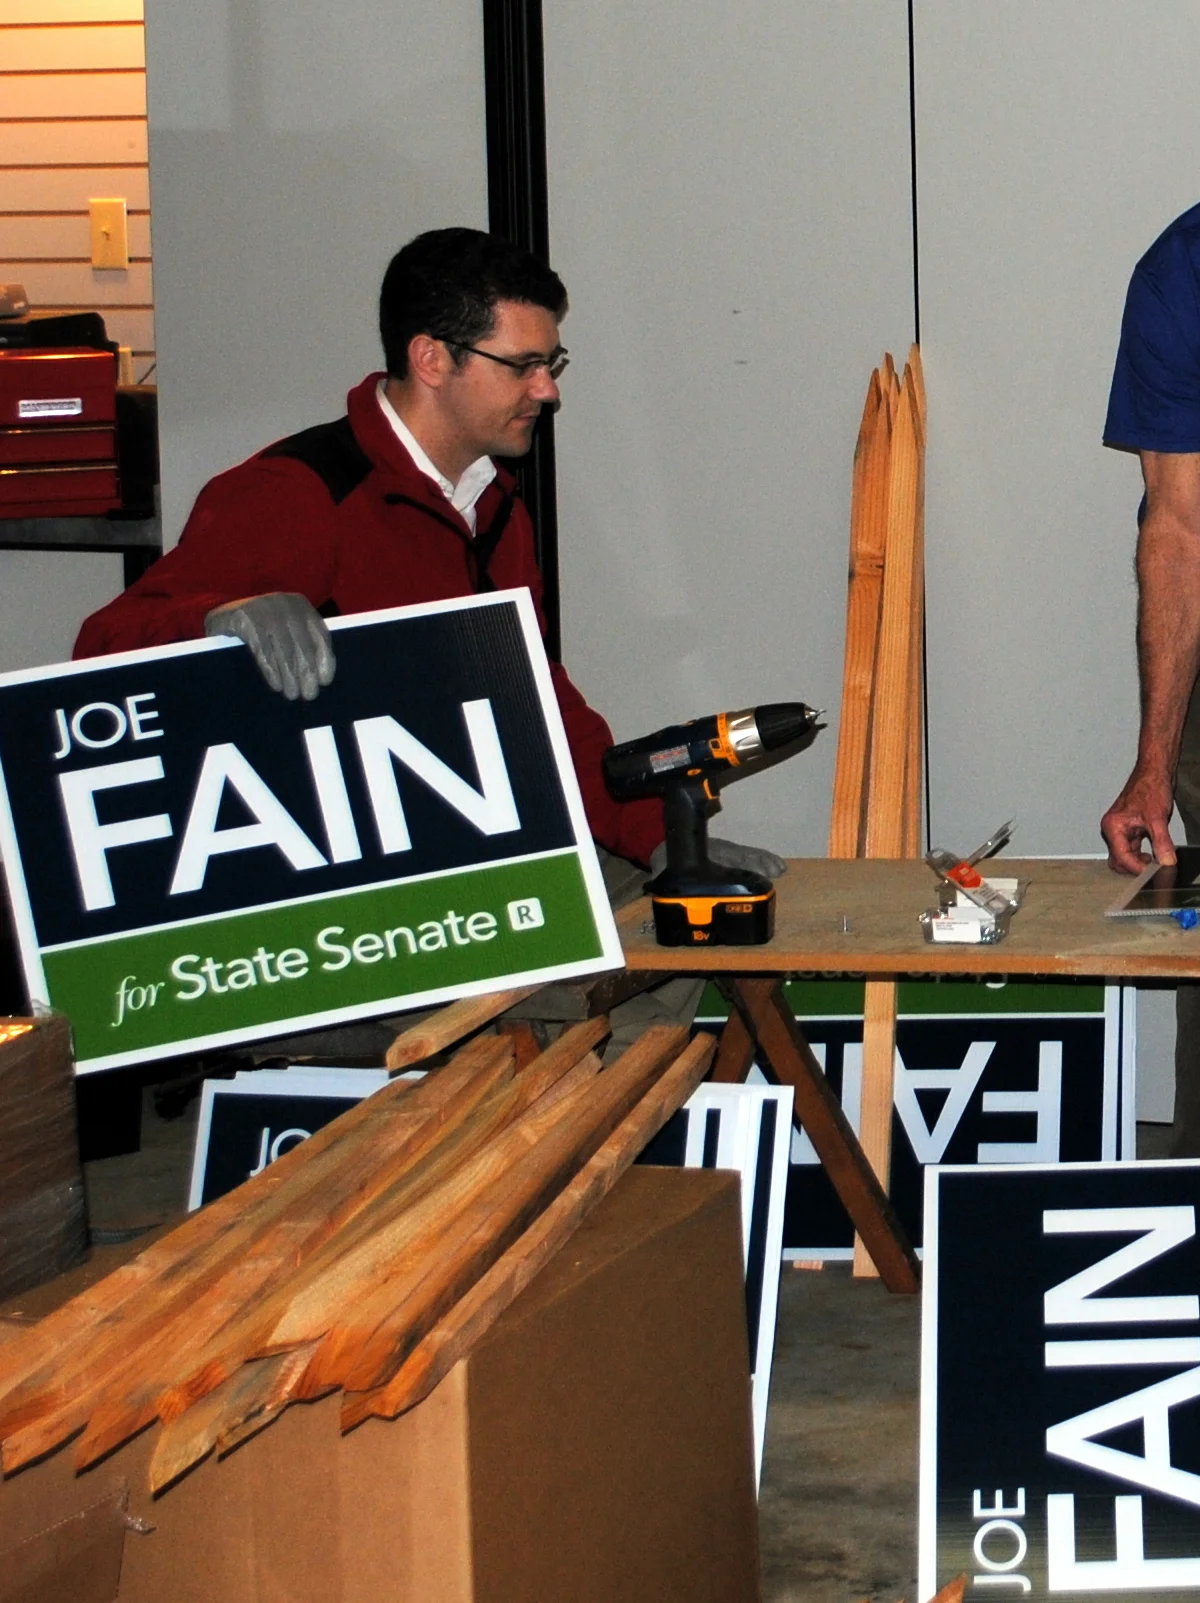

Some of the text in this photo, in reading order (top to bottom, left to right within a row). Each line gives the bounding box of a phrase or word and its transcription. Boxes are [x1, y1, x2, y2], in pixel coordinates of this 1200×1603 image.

[53, 692, 165, 760] JOE
[58, 698, 521, 911] FAIN
[111, 975, 166, 1027] for
[170, 945, 310, 1001] State
[316, 909, 499, 971] Senate
[973, 1486, 1032, 1593] JOE
